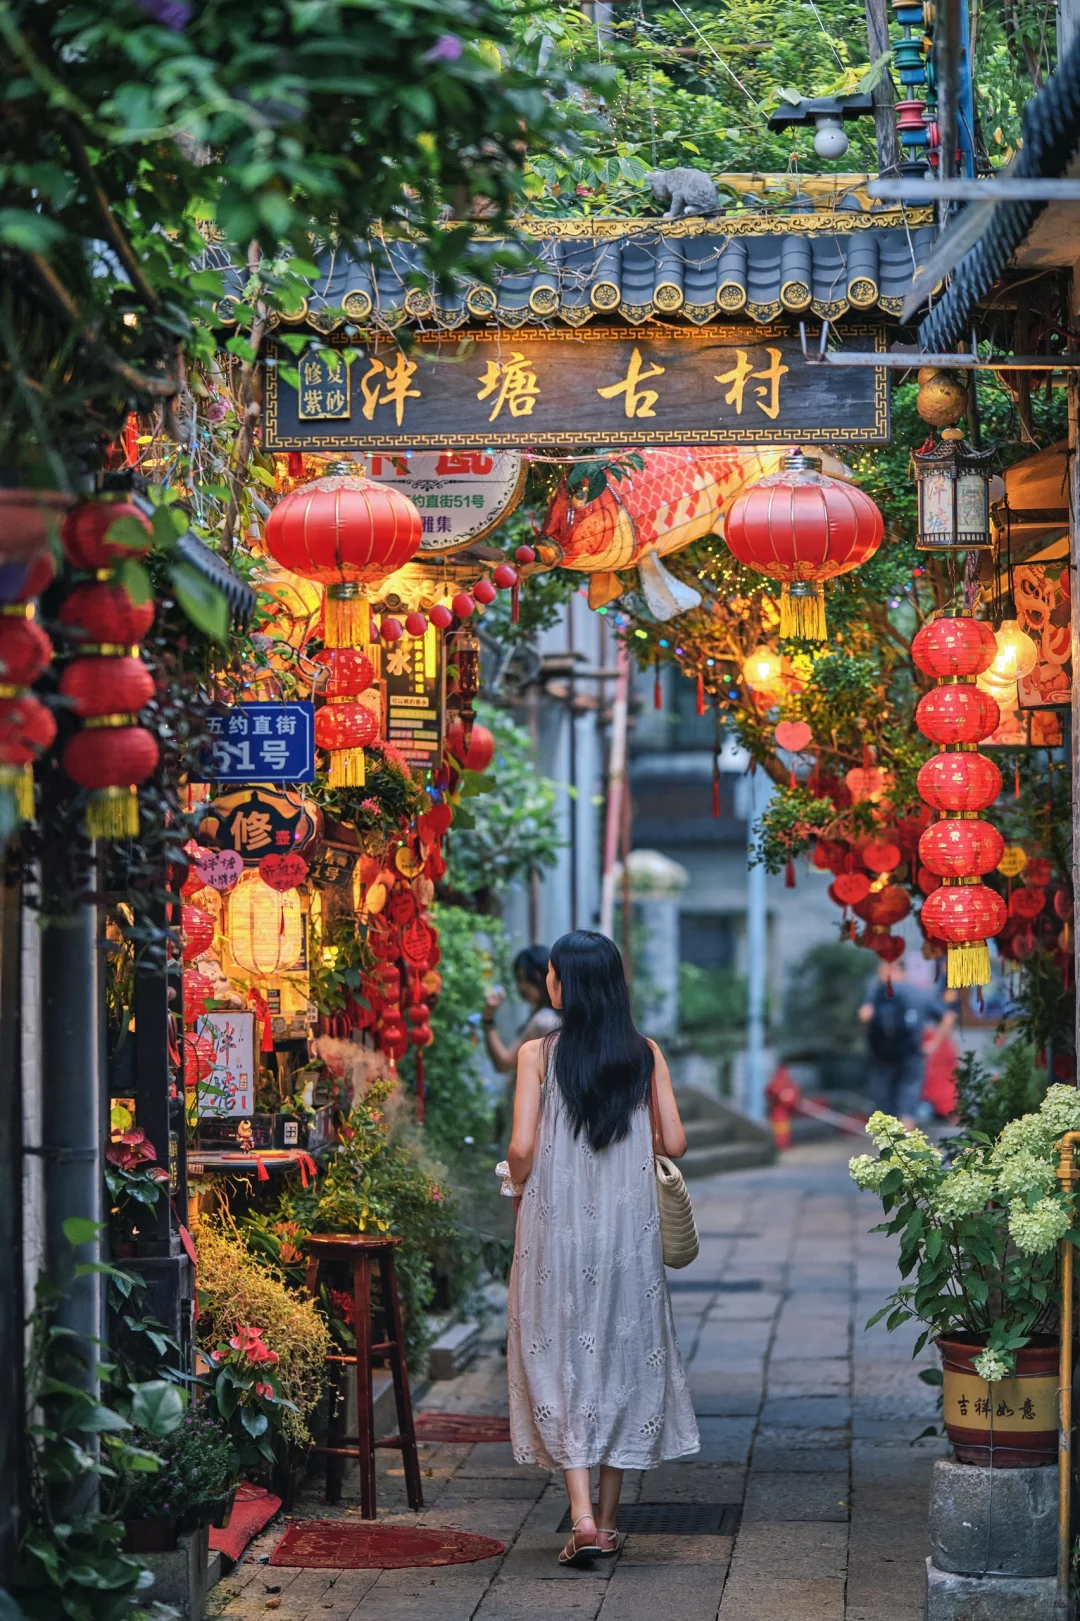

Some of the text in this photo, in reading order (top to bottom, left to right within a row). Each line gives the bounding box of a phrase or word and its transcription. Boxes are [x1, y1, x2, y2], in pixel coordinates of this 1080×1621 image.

[360, 346, 788, 427] 泮塘古村
[304, 390, 345, 414] 紫砂
[406, 494, 485, 509] 约直街51号
[205, 714, 297, 735] 五约直街
[211, 739, 290, 771] 51号
[230, 811, 273, 851] 修
[957, 1394, 1036, 1420] 吉祥如意
